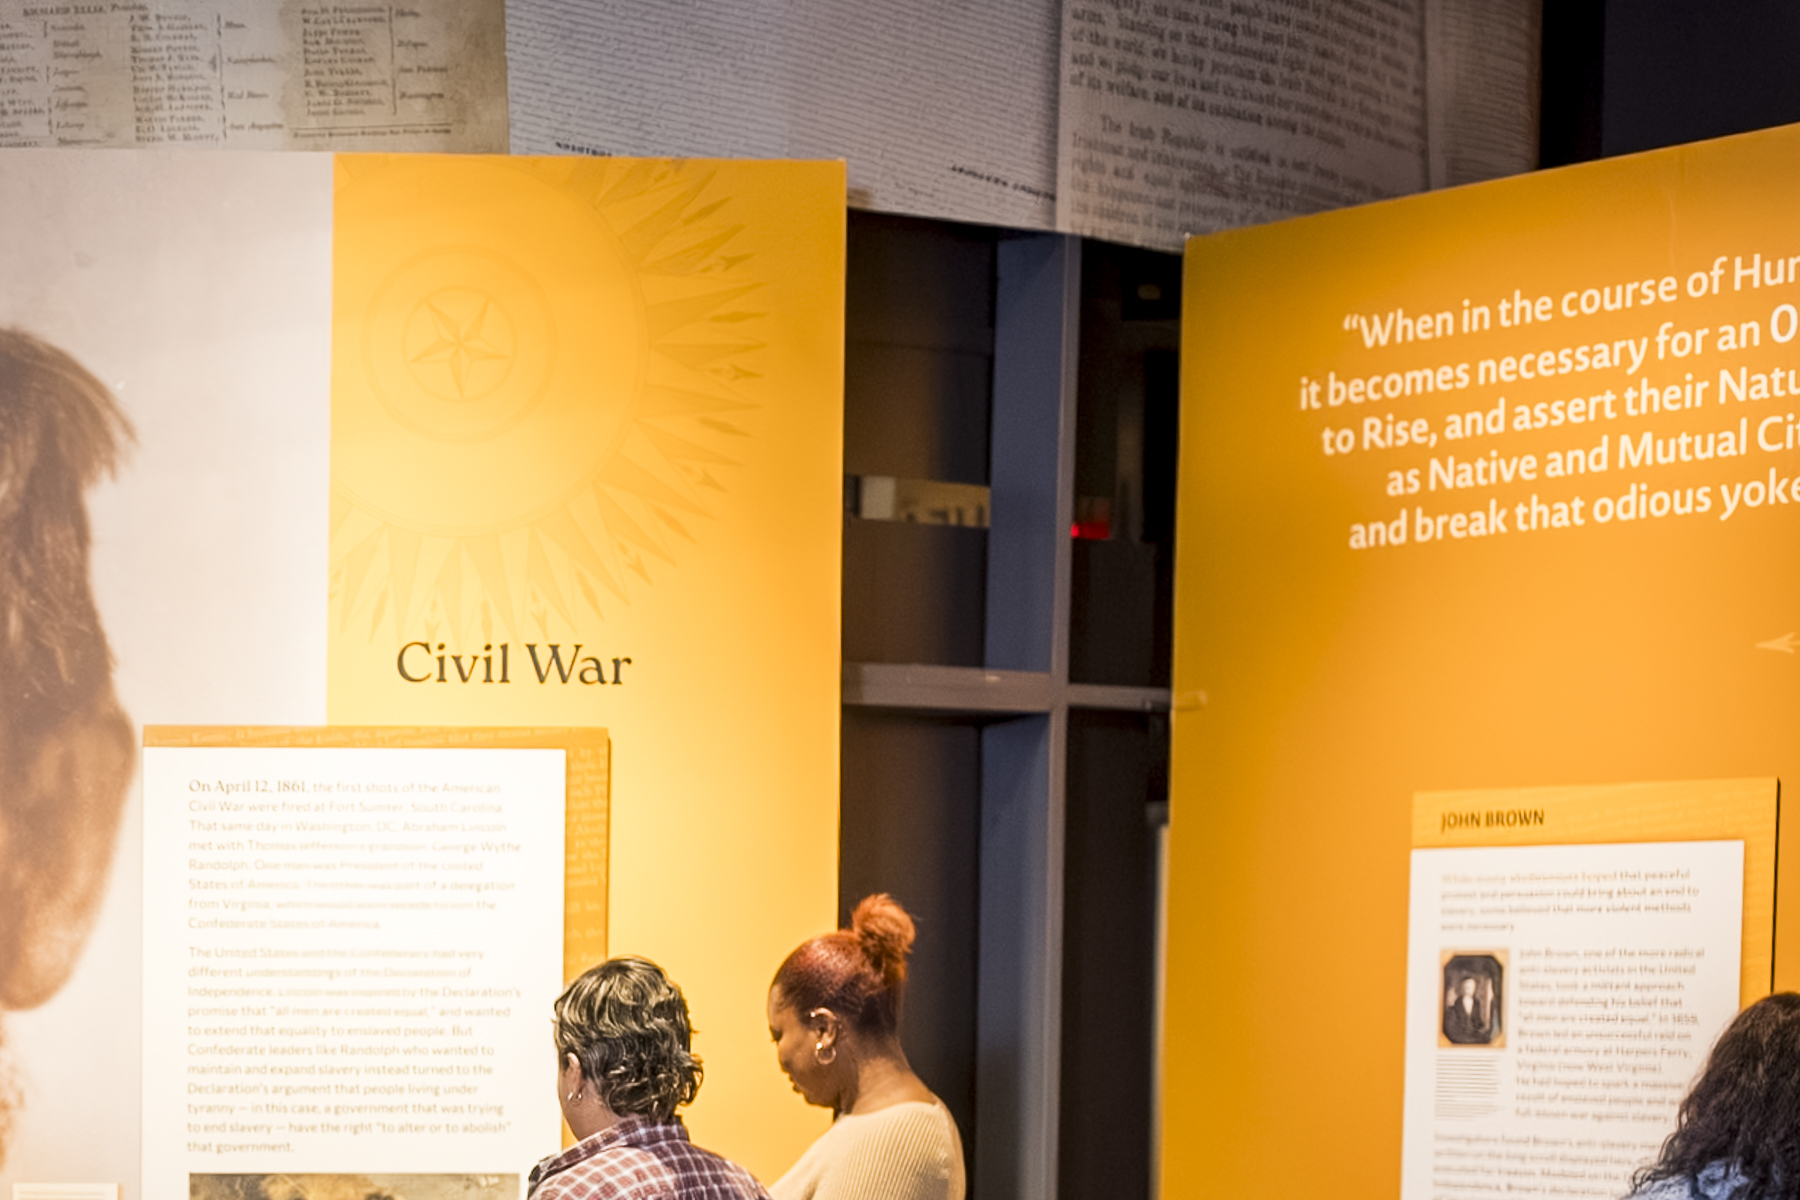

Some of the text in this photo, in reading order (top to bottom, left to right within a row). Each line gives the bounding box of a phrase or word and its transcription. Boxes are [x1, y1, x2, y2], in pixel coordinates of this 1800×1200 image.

[1344, 309, 1453, 347] “When
[1463, 300, 1490, 333] in
[1499, 290, 1552, 327] the
[1562, 277, 1677, 317] course
[1687, 257, 1727, 297] of
[1301, 378, 1321, 409] it
[1329, 363, 1469, 405] becomes
[1479, 338, 1648, 384] necessary
[1656, 322, 1709, 359] for
[1717, 321, 1759, 351] an
[1323, 428, 1354, 454] to
[1364, 414, 1437, 449] Rise,
[1445, 397, 1505, 439] and
[1513, 390, 1616, 430] assert
[1624, 373, 1709, 415] their
[1388, 469, 1420, 495] as
[1430, 450, 1537, 490] Native
[1546, 435, 1608, 477] and
[1619, 418, 1747, 468] Mutual
[1350, 509, 1407, 548] and
[1416, 499, 1507, 541] break
[1516, 495, 1584, 531] that
[1594, 483, 1711, 522] odious
[397, 641, 633, 686] Civil War
[189, 780, 211, 792] On
[215, 780, 250, 795] April
[256, 780, 272, 792] 12,
[278, 781, 308, 792] 1861,
[1441, 809, 1545, 833] JOHN BROWN
[187, 1142, 294, 1154] that government.
